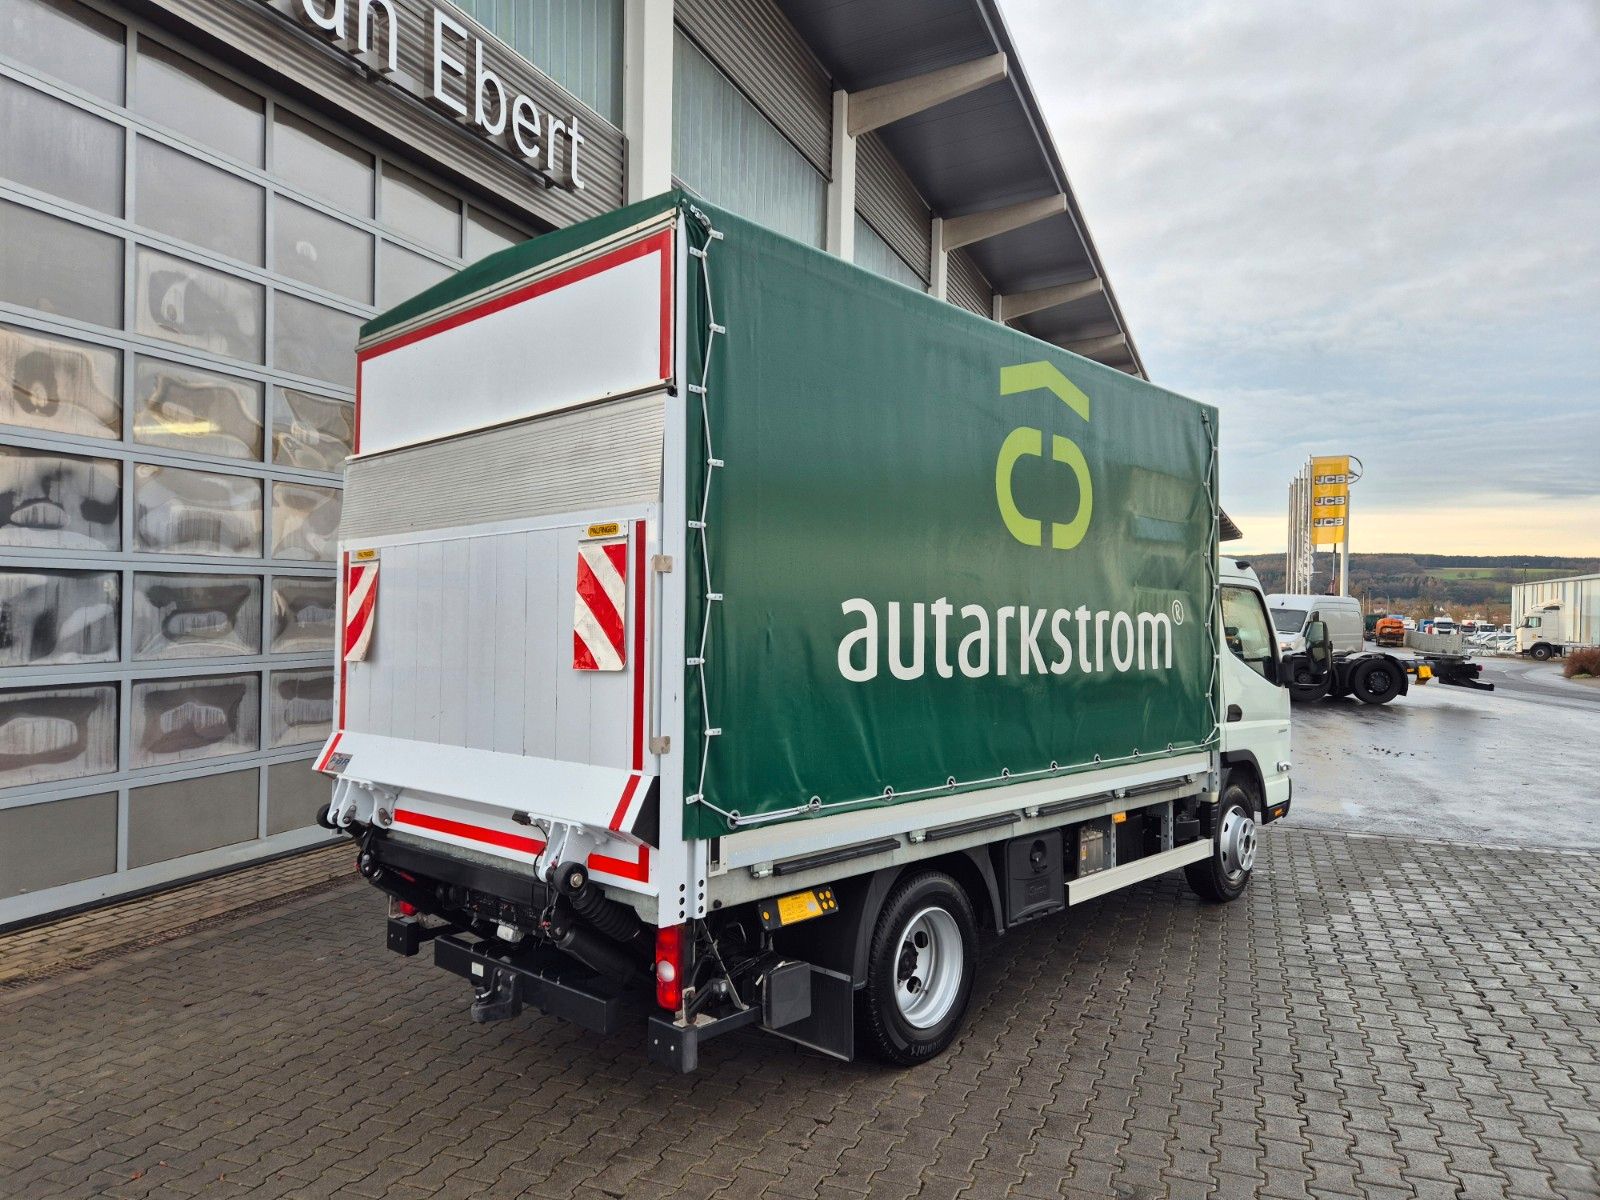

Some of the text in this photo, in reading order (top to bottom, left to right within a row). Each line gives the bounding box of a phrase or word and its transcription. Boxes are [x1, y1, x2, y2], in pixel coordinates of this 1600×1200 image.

[433, 8, 584, 189] Ebert
[1315, 475, 1346, 485] JCB
[1314, 496, 1345, 506] JCB
[1314, 518, 1344, 527] JCB
